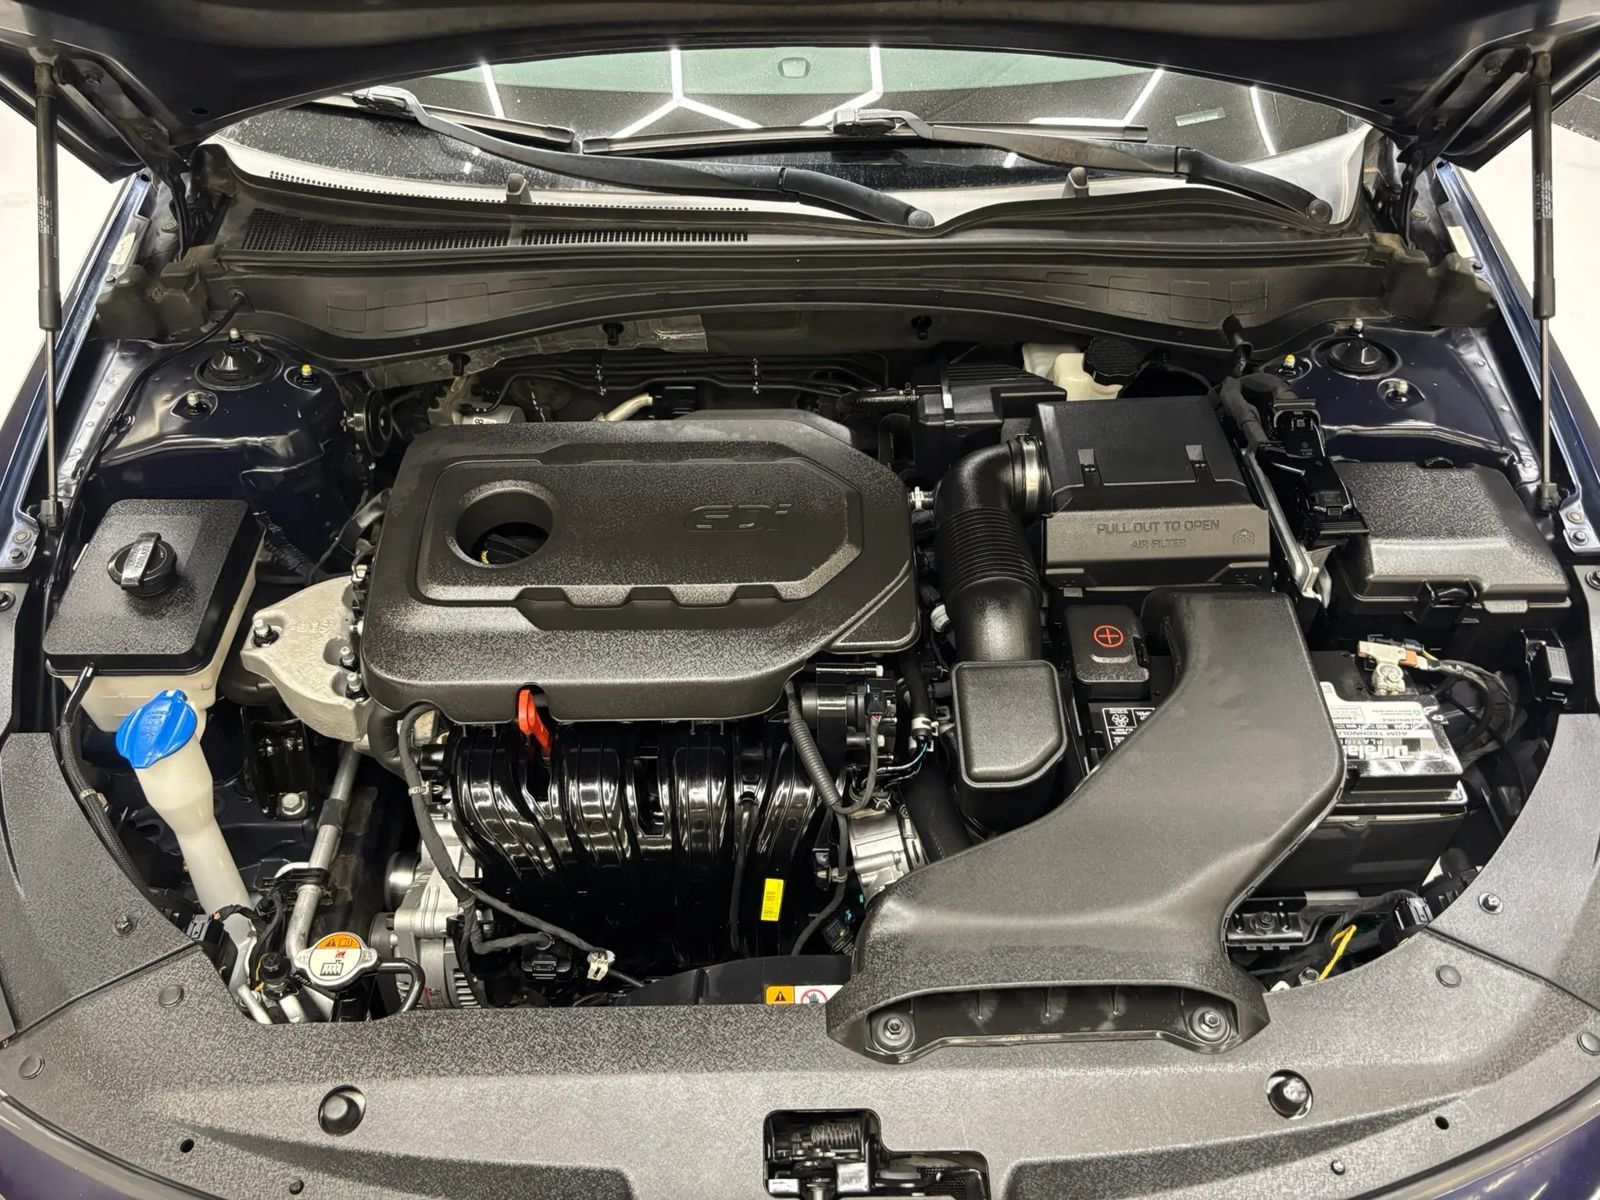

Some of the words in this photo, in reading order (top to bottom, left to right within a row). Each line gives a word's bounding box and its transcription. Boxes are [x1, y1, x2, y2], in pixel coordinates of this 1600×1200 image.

[1097, 522, 1131, 534] PULL
[1133, 521, 1160, 534] OUT
[1164, 520, 1181, 532] TO
[1184, 519, 1220, 531] OPEN
[1131, 540, 1149, 549] AIR
[1151, 538, 1187, 548] FILTER
